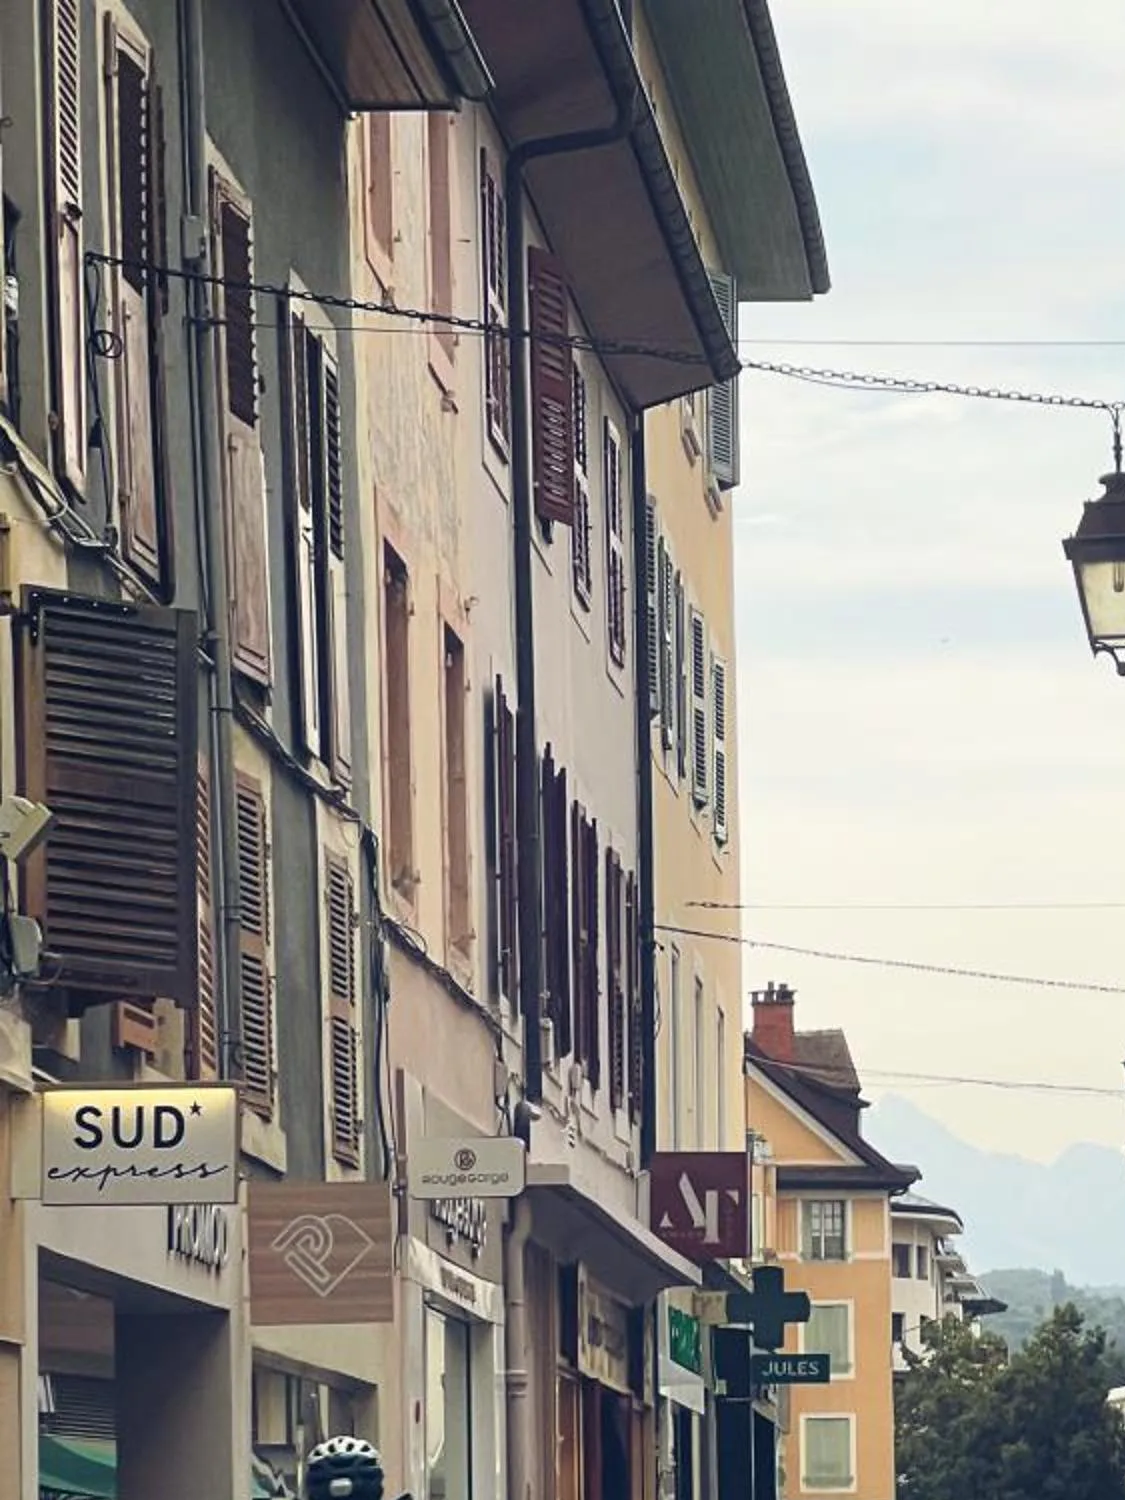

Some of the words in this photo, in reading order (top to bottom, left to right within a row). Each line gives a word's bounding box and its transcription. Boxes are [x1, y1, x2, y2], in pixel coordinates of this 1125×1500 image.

[74, 1105, 185, 1149] SUD
[47, 1162, 229, 1191] express
[762, 1361, 819, 1377] JULES
